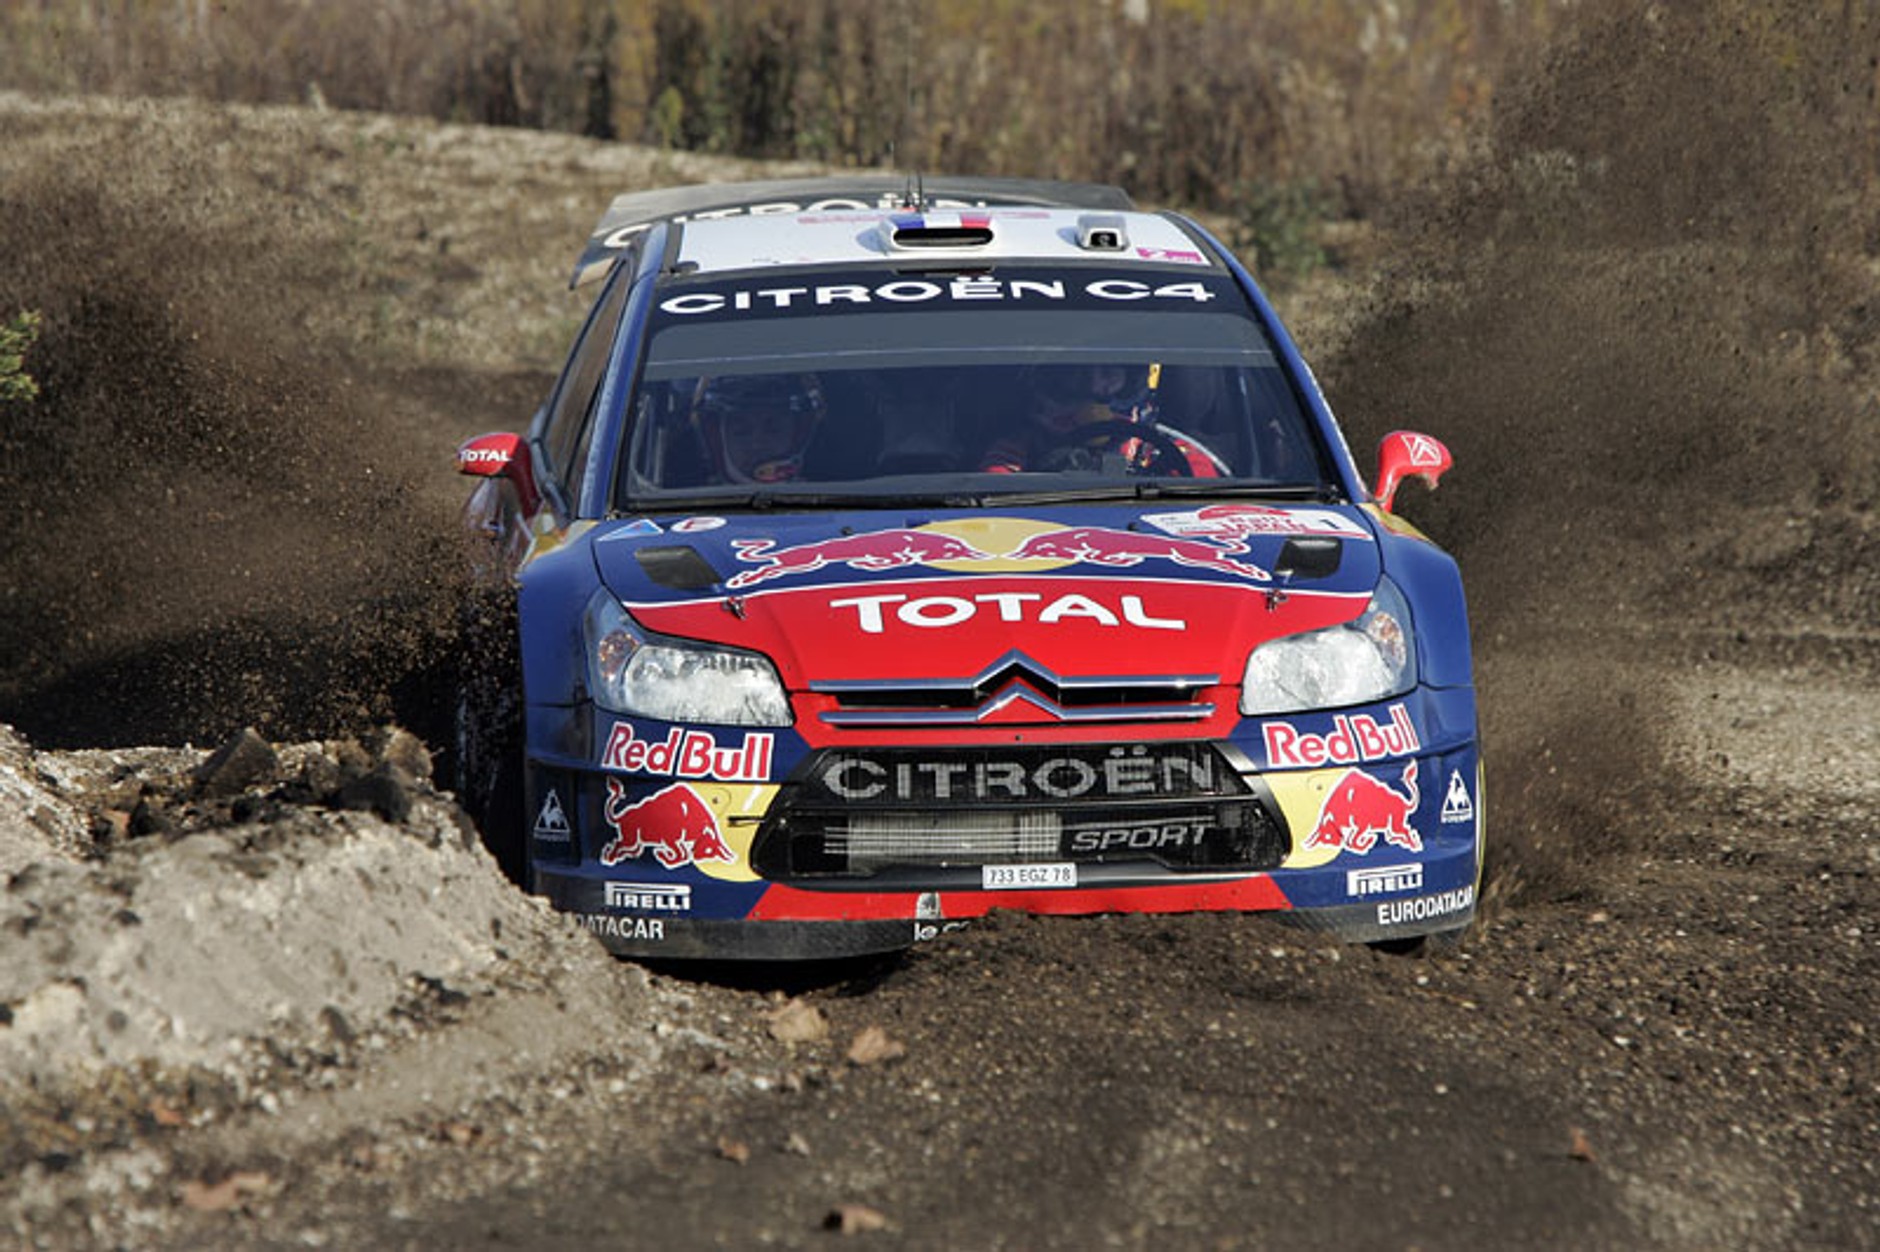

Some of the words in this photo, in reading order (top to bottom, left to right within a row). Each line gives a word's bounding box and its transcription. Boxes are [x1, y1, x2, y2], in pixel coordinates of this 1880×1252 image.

[660, 275, 1065, 315] CITROËN
[1086, 279, 1216, 302] C4
[460, 448, 512, 463] TOTAL
[829, 592, 1186, 633] TOTAL
[603, 721, 680, 777] Red
[678, 730, 774, 782] Bull
[1263, 714, 1357, 768] Red
[1350, 703, 1420, 761] Bull
[821, 745, 1214, 799] CITROËN
[1071, 823, 1212, 852] SPORT
[989, 868, 1015, 883] 733
[1020, 868, 1048, 882] EGZ
[1053, 867, 1071, 882] 78
[1347, 862, 1423, 896] PIRELLI
[604, 881, 691, 910] PIRELLI
